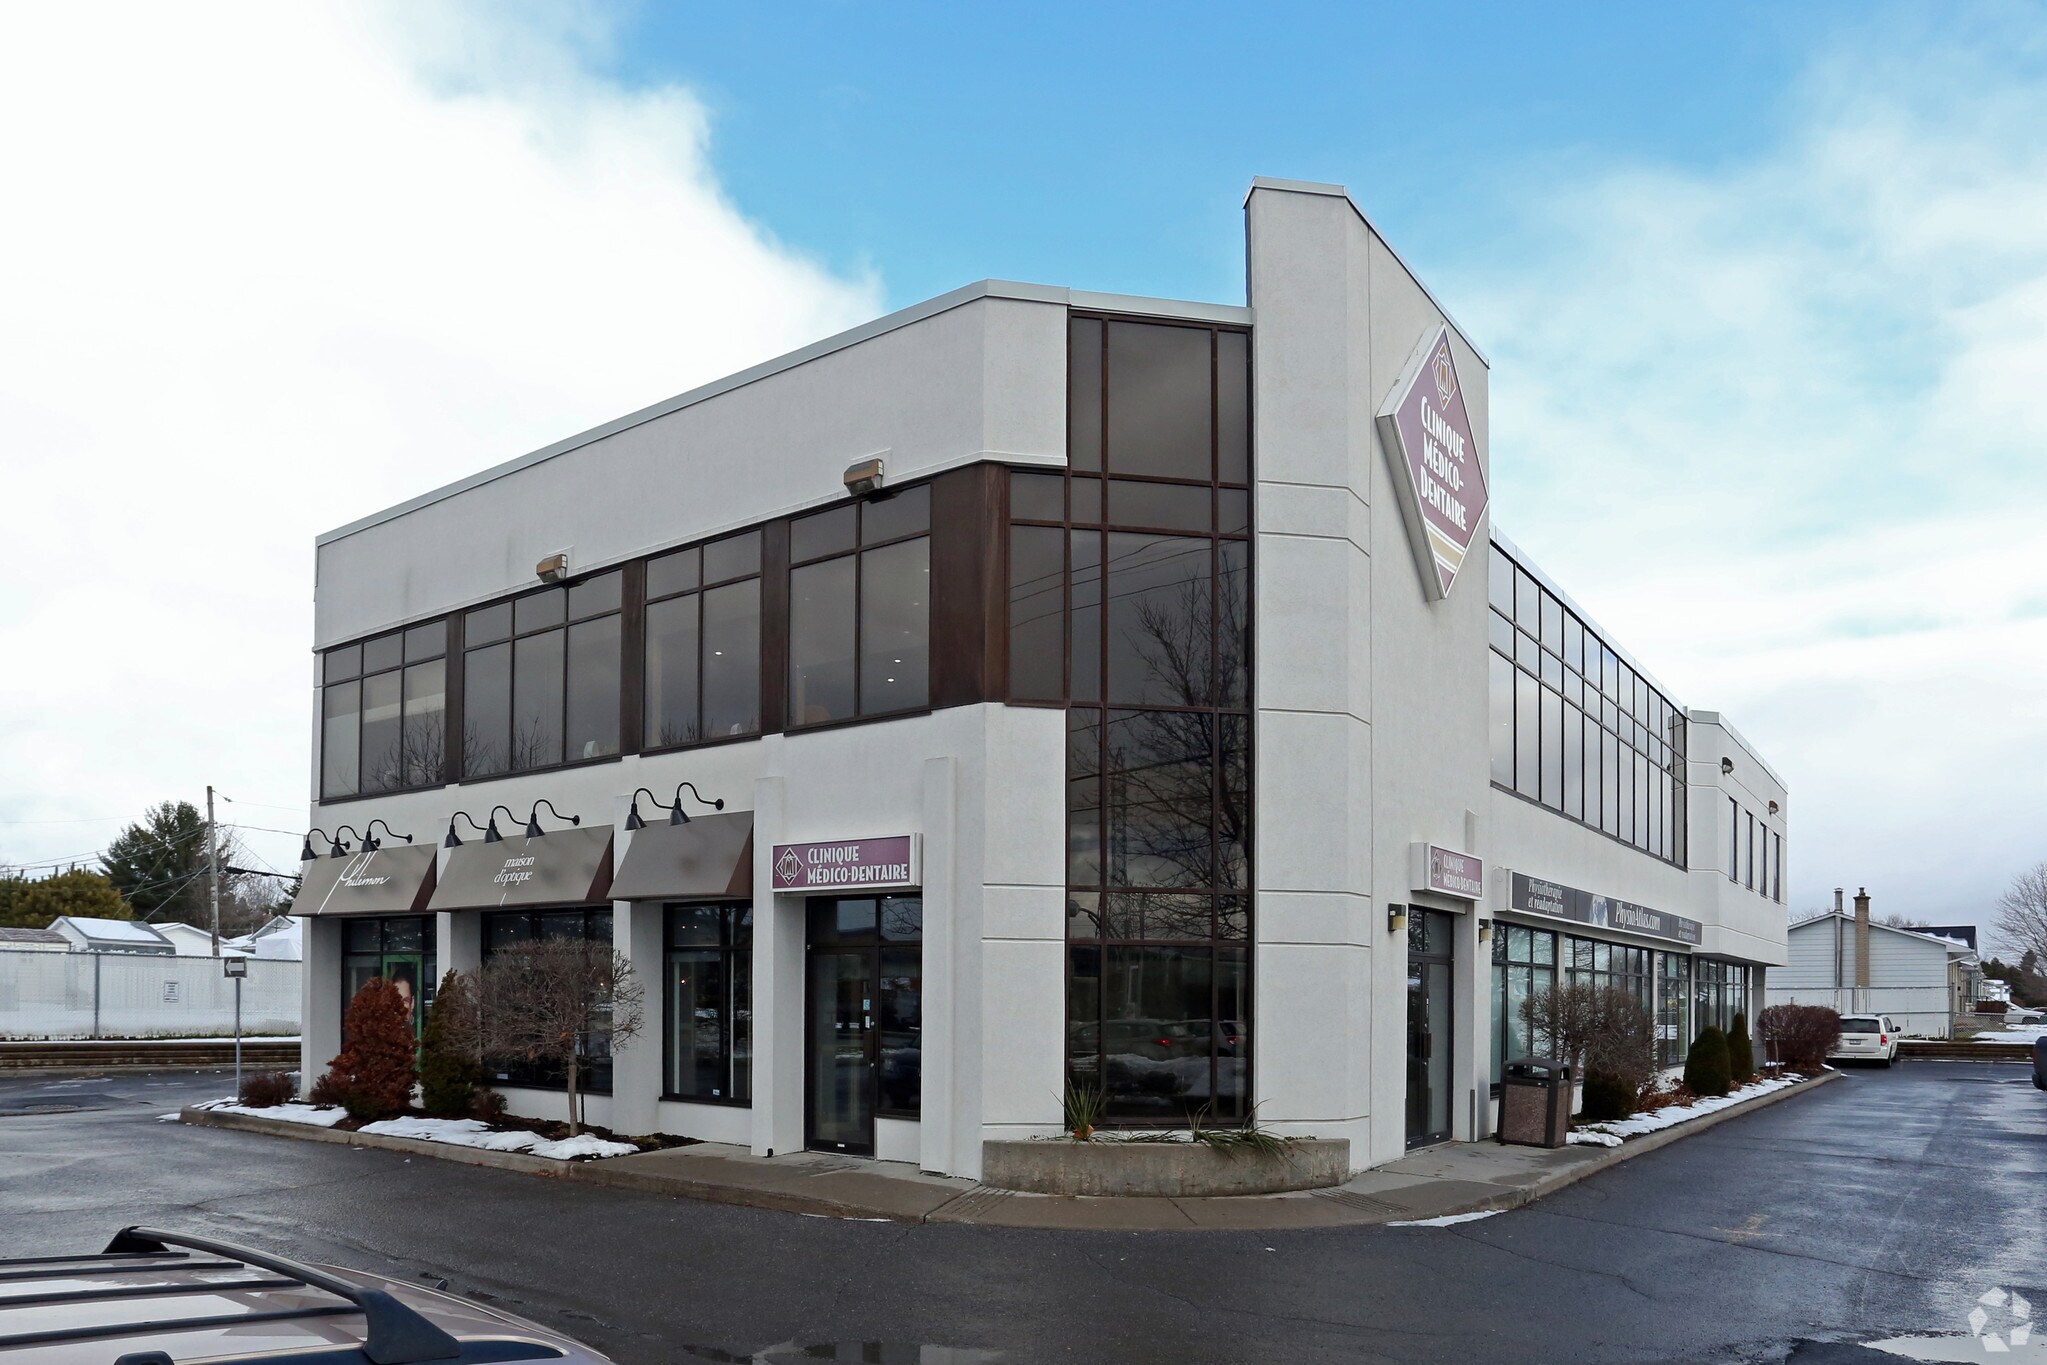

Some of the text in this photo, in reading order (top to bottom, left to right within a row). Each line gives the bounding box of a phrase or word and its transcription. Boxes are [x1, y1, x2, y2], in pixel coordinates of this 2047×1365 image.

[1420, 395, 1465, 464] CLINIQUE
[1423, 432, 1464, 493] MÉDICO-
[1420, 464, 1467, 532] DENTAIRE
[504, 853, 535, 868] maison
[807, 845, 860, 865] CLINIQUE
[1443, 854, 1464, 874] CLINIQUE
[807, 863, 908, 884] MÉDICO-DENTAIRE
